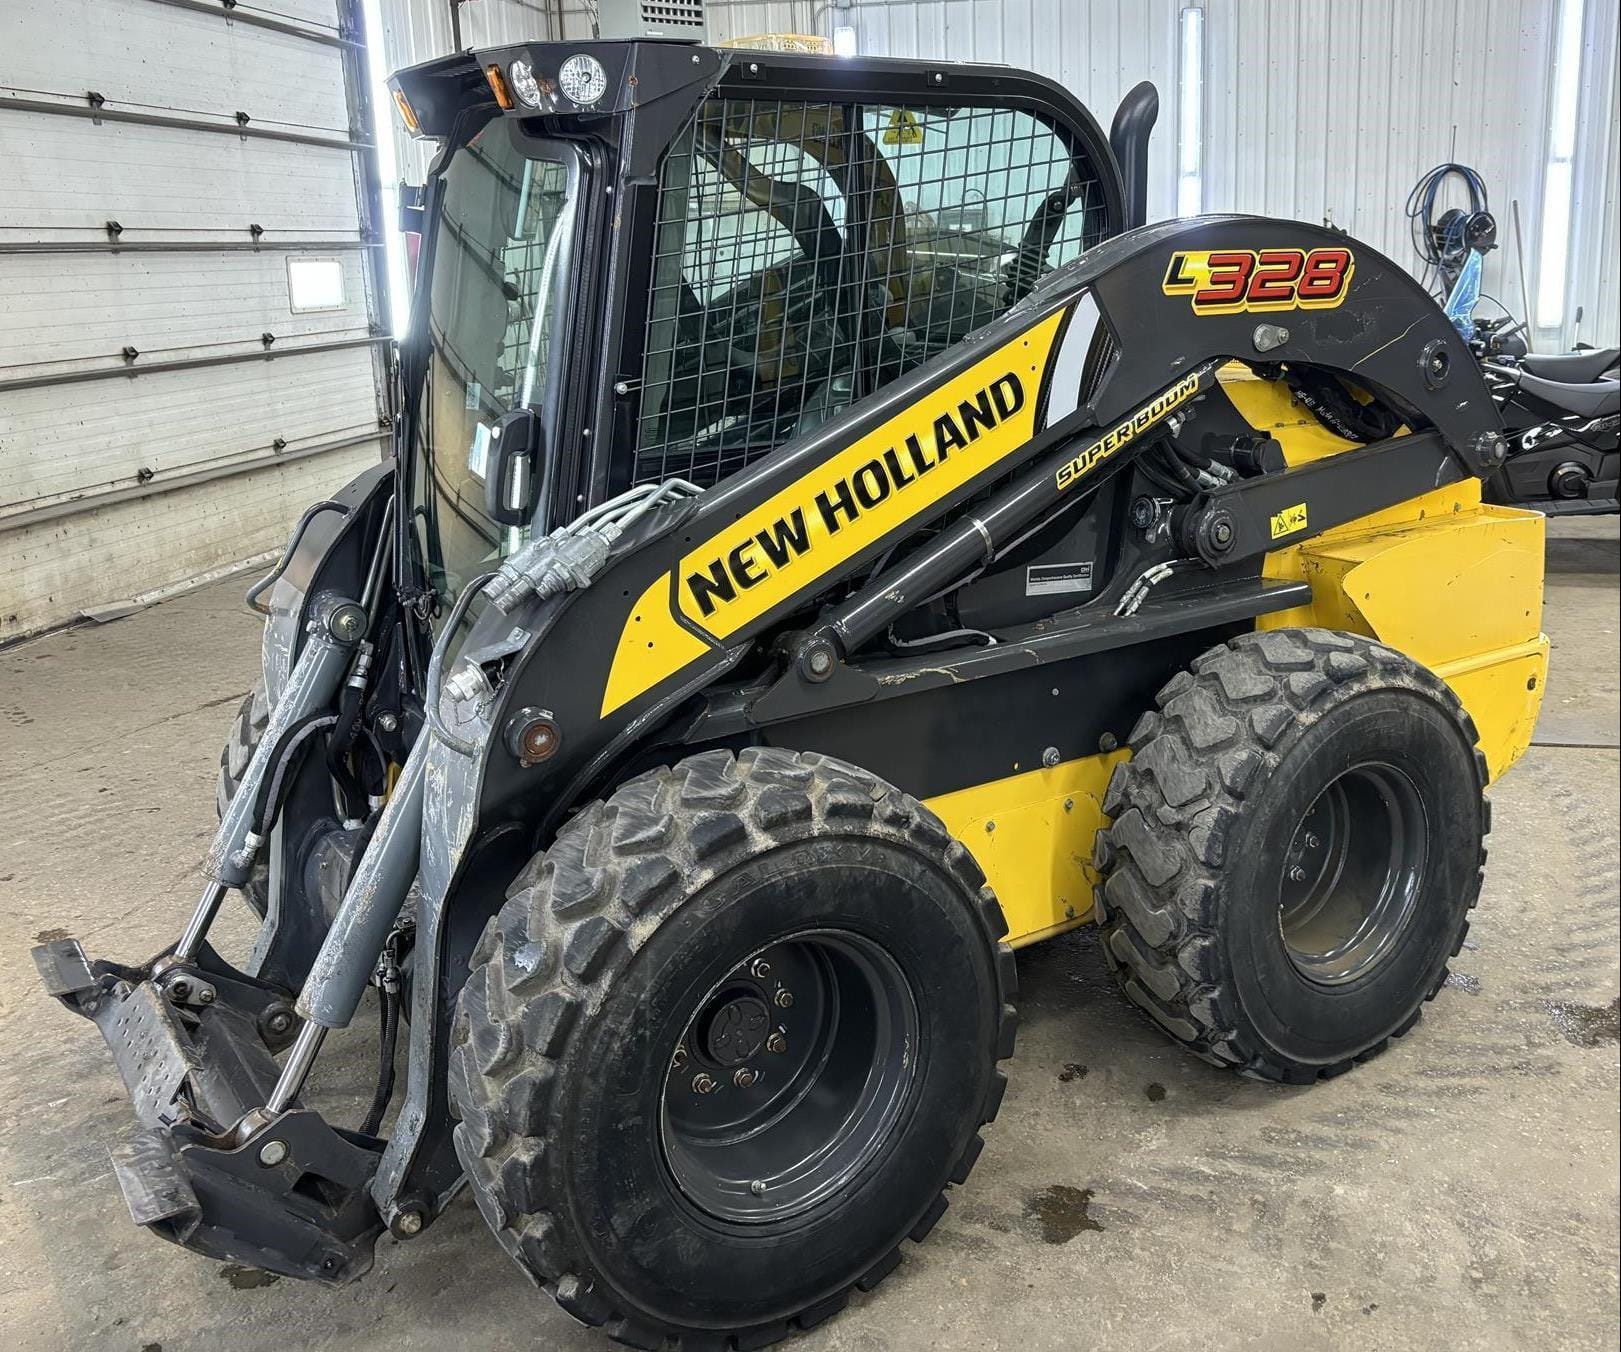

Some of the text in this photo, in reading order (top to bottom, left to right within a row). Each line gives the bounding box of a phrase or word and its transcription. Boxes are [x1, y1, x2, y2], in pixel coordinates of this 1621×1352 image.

[686, 371, 1026, 618] NEW HOLLAND
[1056, 372, 1199, 490] SUPER BOOM
